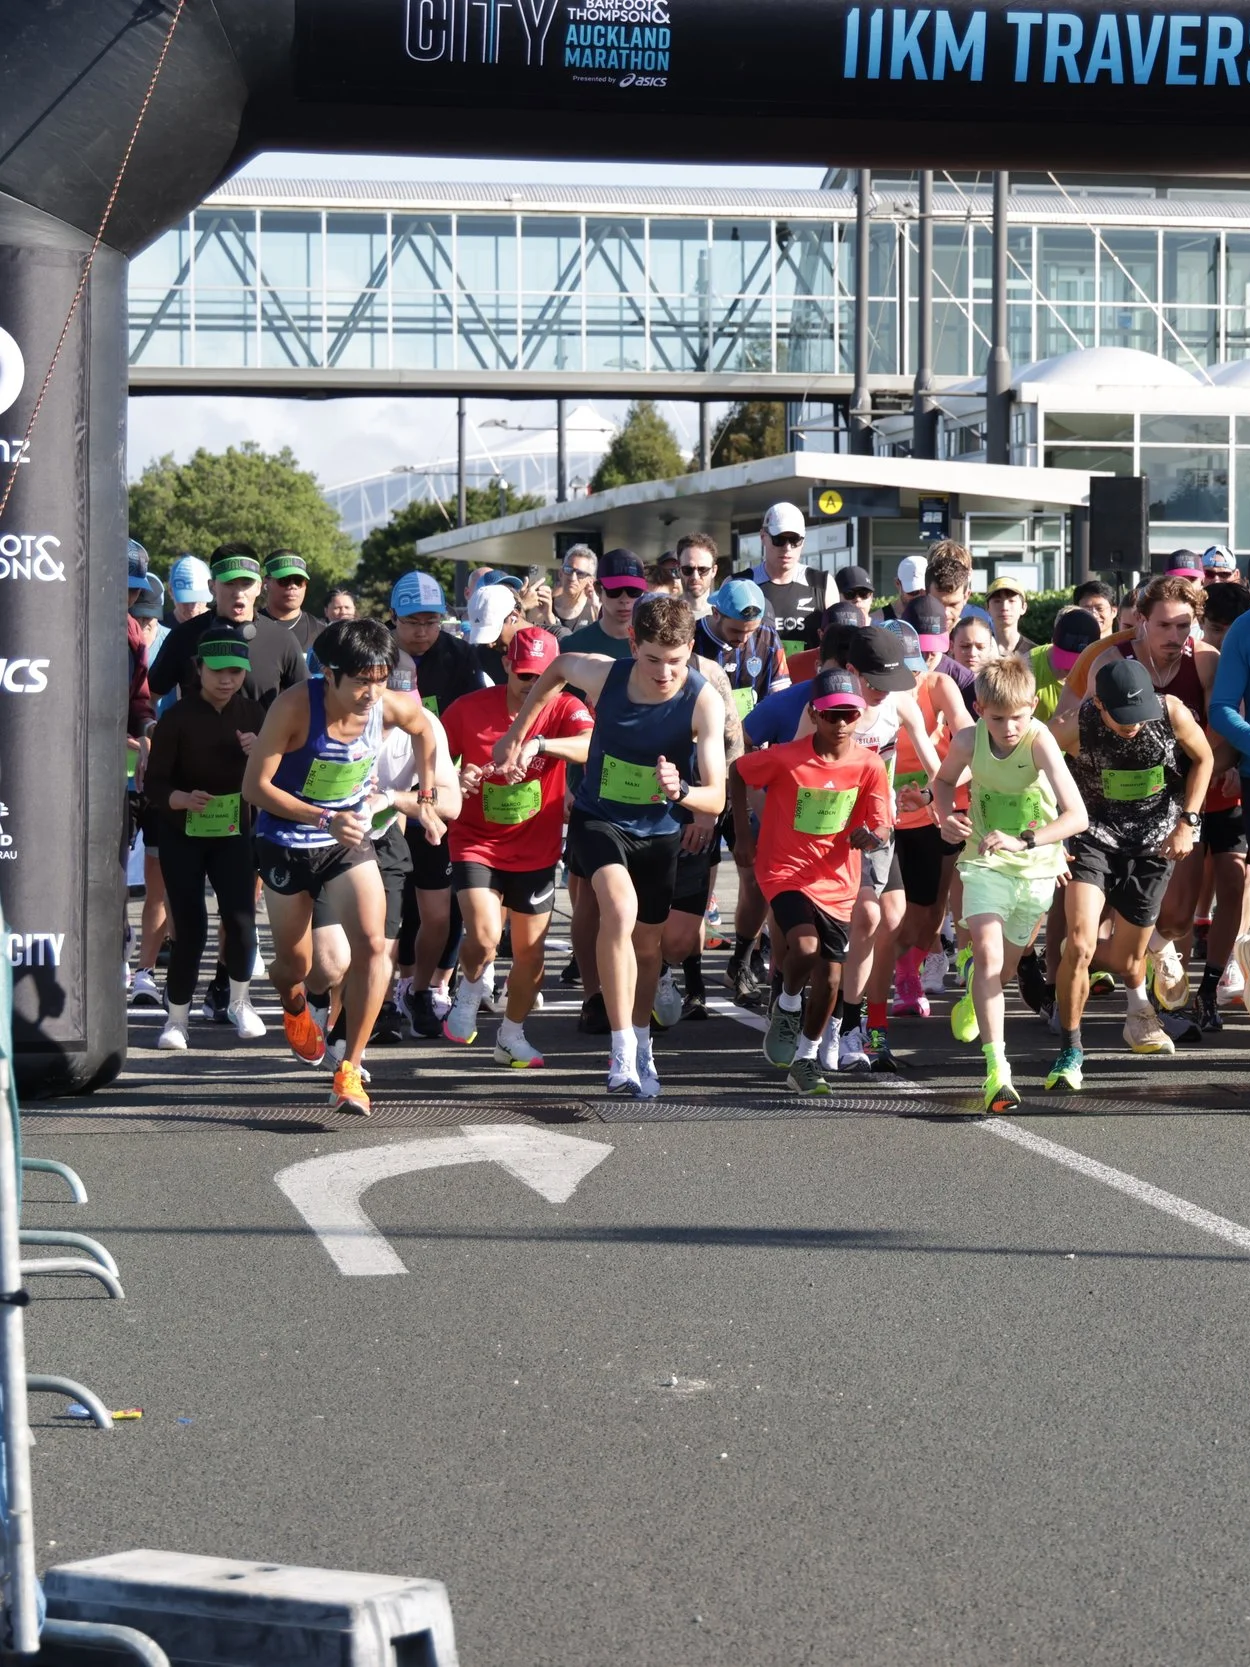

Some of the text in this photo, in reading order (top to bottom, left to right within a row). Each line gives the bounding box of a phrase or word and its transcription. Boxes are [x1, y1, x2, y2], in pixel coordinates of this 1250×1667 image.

[567, 8, 650, 24] THOMPSON
[405, 0, 558, 66] CITY
[565, 24, 671, 50] AUCKLAND
[564, 47, 670, 72] MARATHON
[572, 75, 607, 83] Presented
[607, 76, 616, 85] by
[825, 495, 836, 509] A
[775, 617, 805, 631] EOS
